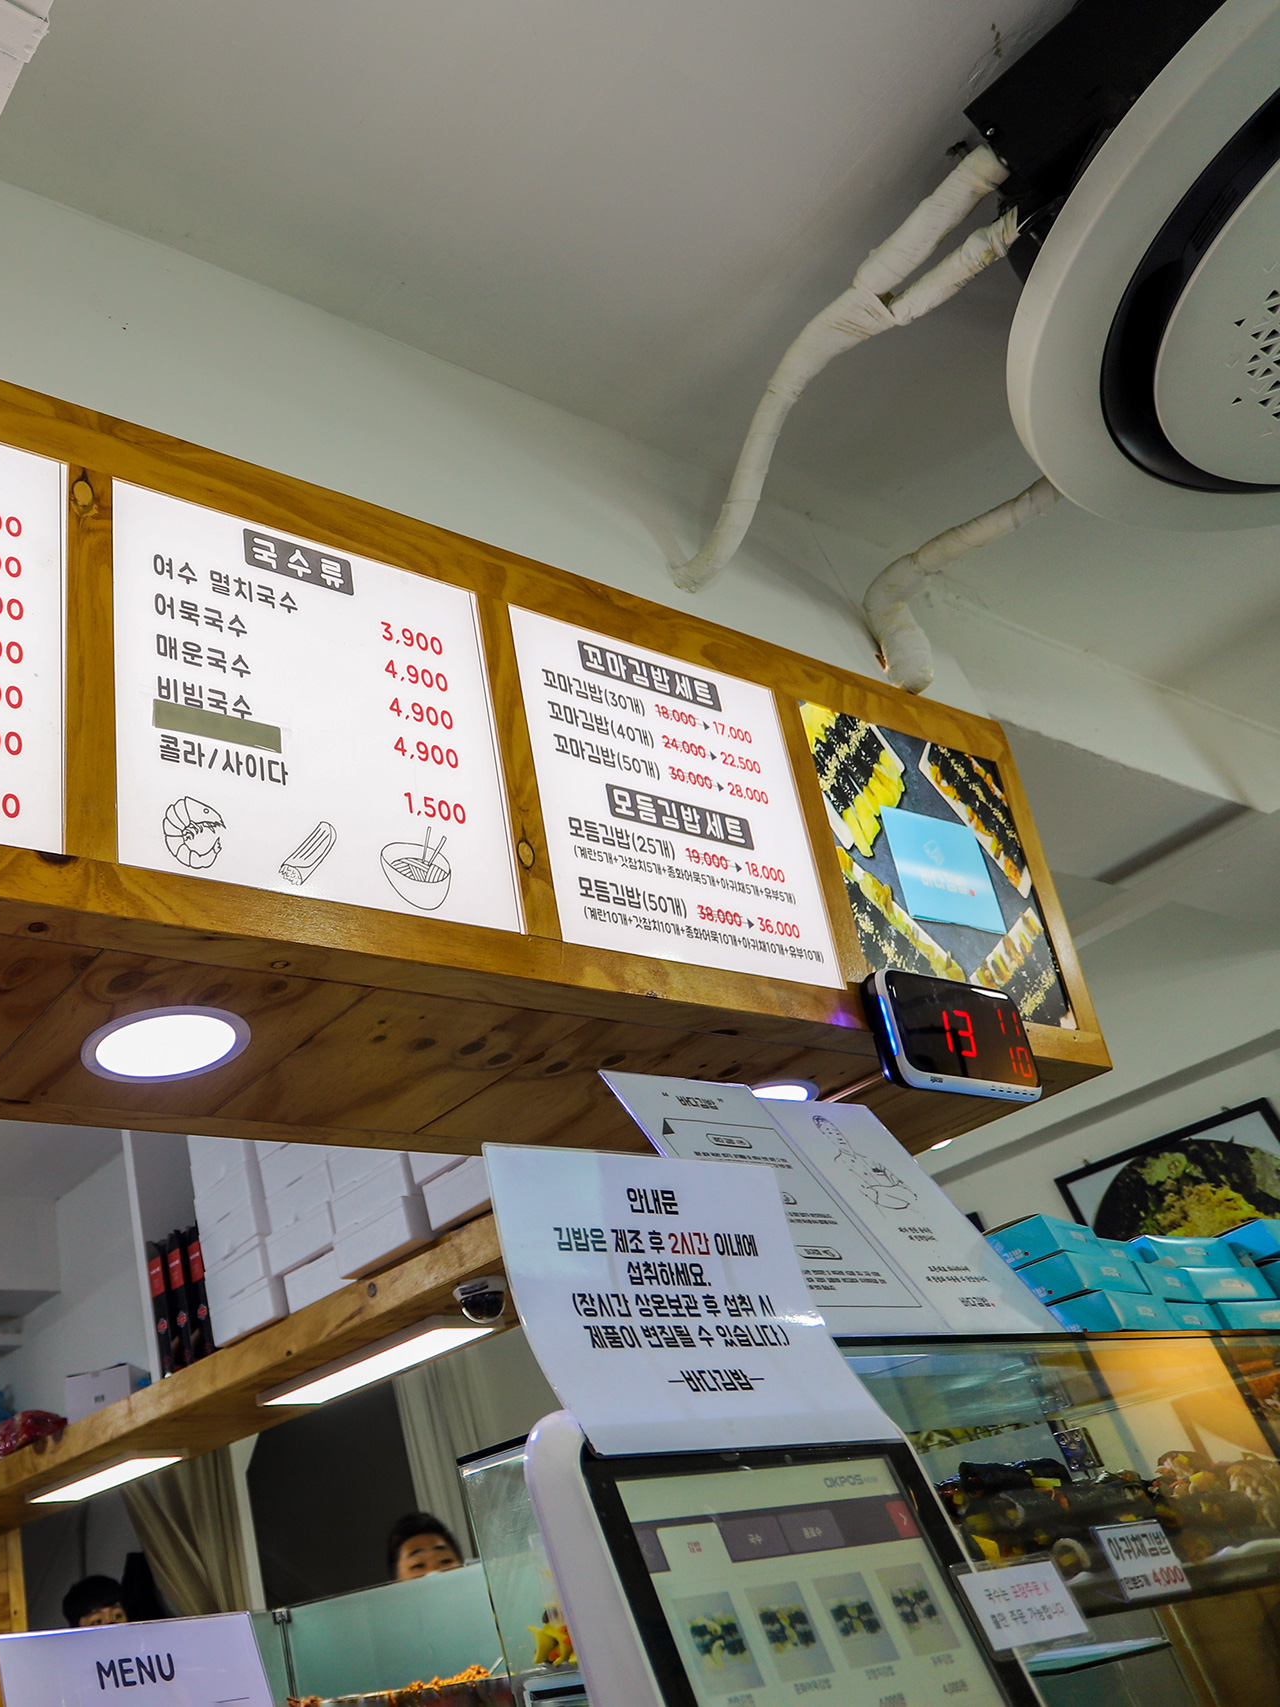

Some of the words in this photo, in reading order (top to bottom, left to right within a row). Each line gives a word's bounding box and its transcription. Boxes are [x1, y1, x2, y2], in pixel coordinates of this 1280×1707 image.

[251, 536, 344, 588] 국수류
[153, 554, 198, 585] 여수
[210, 569, 298, 614] 멸치국수
[153, 593, 248, 637] 어묵국수
[380, 621, 443, 655] 3,900
[156, 634, 251, 678] 매운국수
[384, 660, 448, 692] 4,900
[157, 676, 253, 719] 비빔국수
[389, 698, 453, 729] 4,900
[542, 669, 645, 717] 꼬마김밥(30개)
[655, 704, 697, 727] 18,000
[713, 721, 752, 744] 17,000
[393, 737, 459, 768] 4,900
[548, 700, 654, 748] 꼬마김밥(40개)
[662, 735, 706, 759] 24,000
[720, 751, 761, 775] 22,500
[160, 734, 289, 786] 콜라/사이다
[553, 733, 660, 781] 꼬마김밥(50개)
[669, 766, 713, 790] 30,000
[728, 782, 769, 805] 28,000
[404, 792, 466, 824] 1,500
[568, 816, 676, 860] 모듬김밥(25개)
[686, 847, 728, 870] 19,000
[745, 861, 785, 883] 18,000
[579, 876, 687, 918] 모듬김밥(50개)
[697, 905, 742, 927] 38,000
[757, 916, 800, 939] 36,000
[942, 1009, 977, 1057] 13
[627, 1188, 679, 1215] 안내문
[553, 1227, 607, 1252] 김밥은
[611, 1229, 645, 1254] 제조
[648, 1230, 665, 1254] 후
[668, 1232, 711, 1255] 2시간
[714, 1233, 759, 1257] 이내에
[627, 1261, 712, 1287] 섭취하세요.
[572, 1293, 632, 1318] (장시간
[635, 1294, 701, 1318] 상온보관
[702, 1294, 721, 1319] 후
[724, 1295, 757, 1318] 섭취
[584, 1326, 642, 1348] 제품이
[698, 1326, 714, 1347] 수
[1107, 1531, 1171, 1561] 아귀채김밥
[1152, 1566, 1184, 1587] 4,000
[984, 1587, 1010, 1603] 국수는
[96, 1653, 175, 1690] MENU
